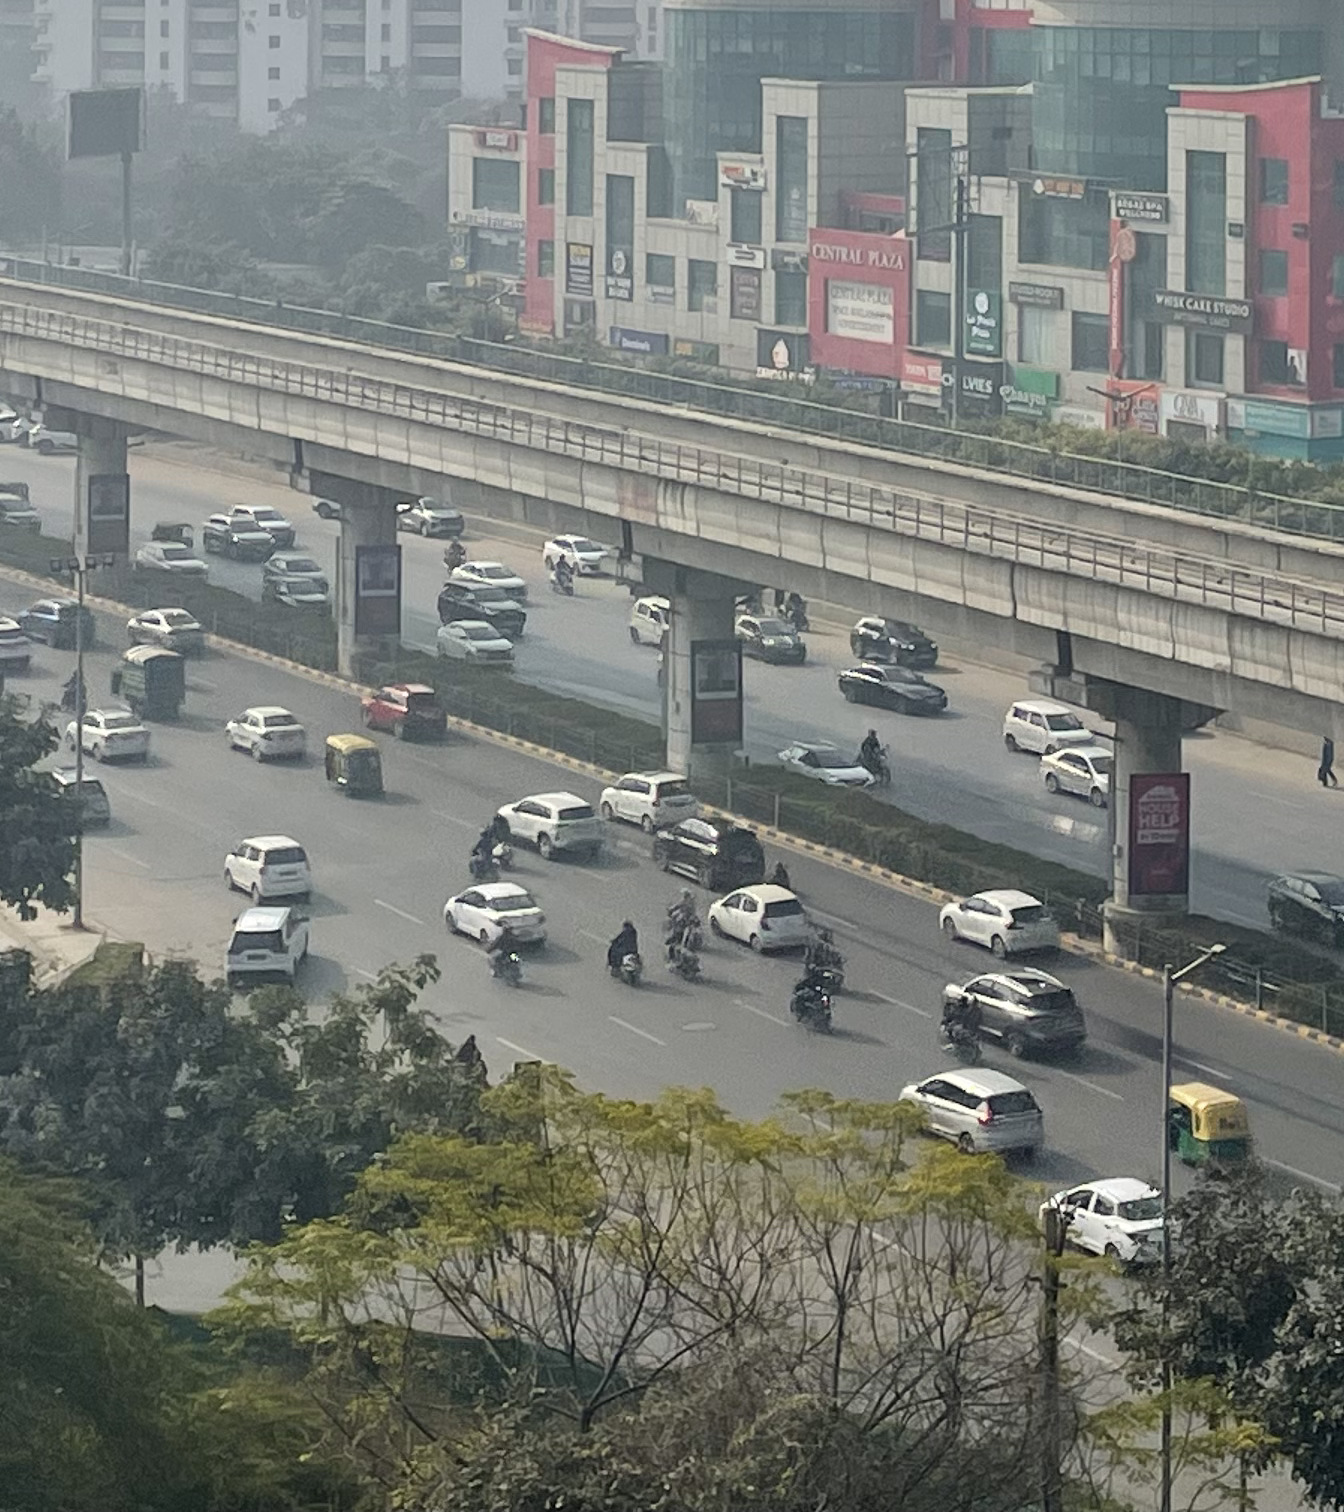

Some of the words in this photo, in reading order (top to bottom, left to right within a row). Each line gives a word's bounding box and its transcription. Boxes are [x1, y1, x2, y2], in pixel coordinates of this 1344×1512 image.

[812, 243, 864, 265] CENTRAL
[868, 250, 904, 270] PLAZA
[1155, 294, 1185, 309] WHISK
[1186, 297, 1212, 313] CAKE
[1213, 302, 1249, 318] STUDIO
[1138, 814, 1180, 829] HELP
